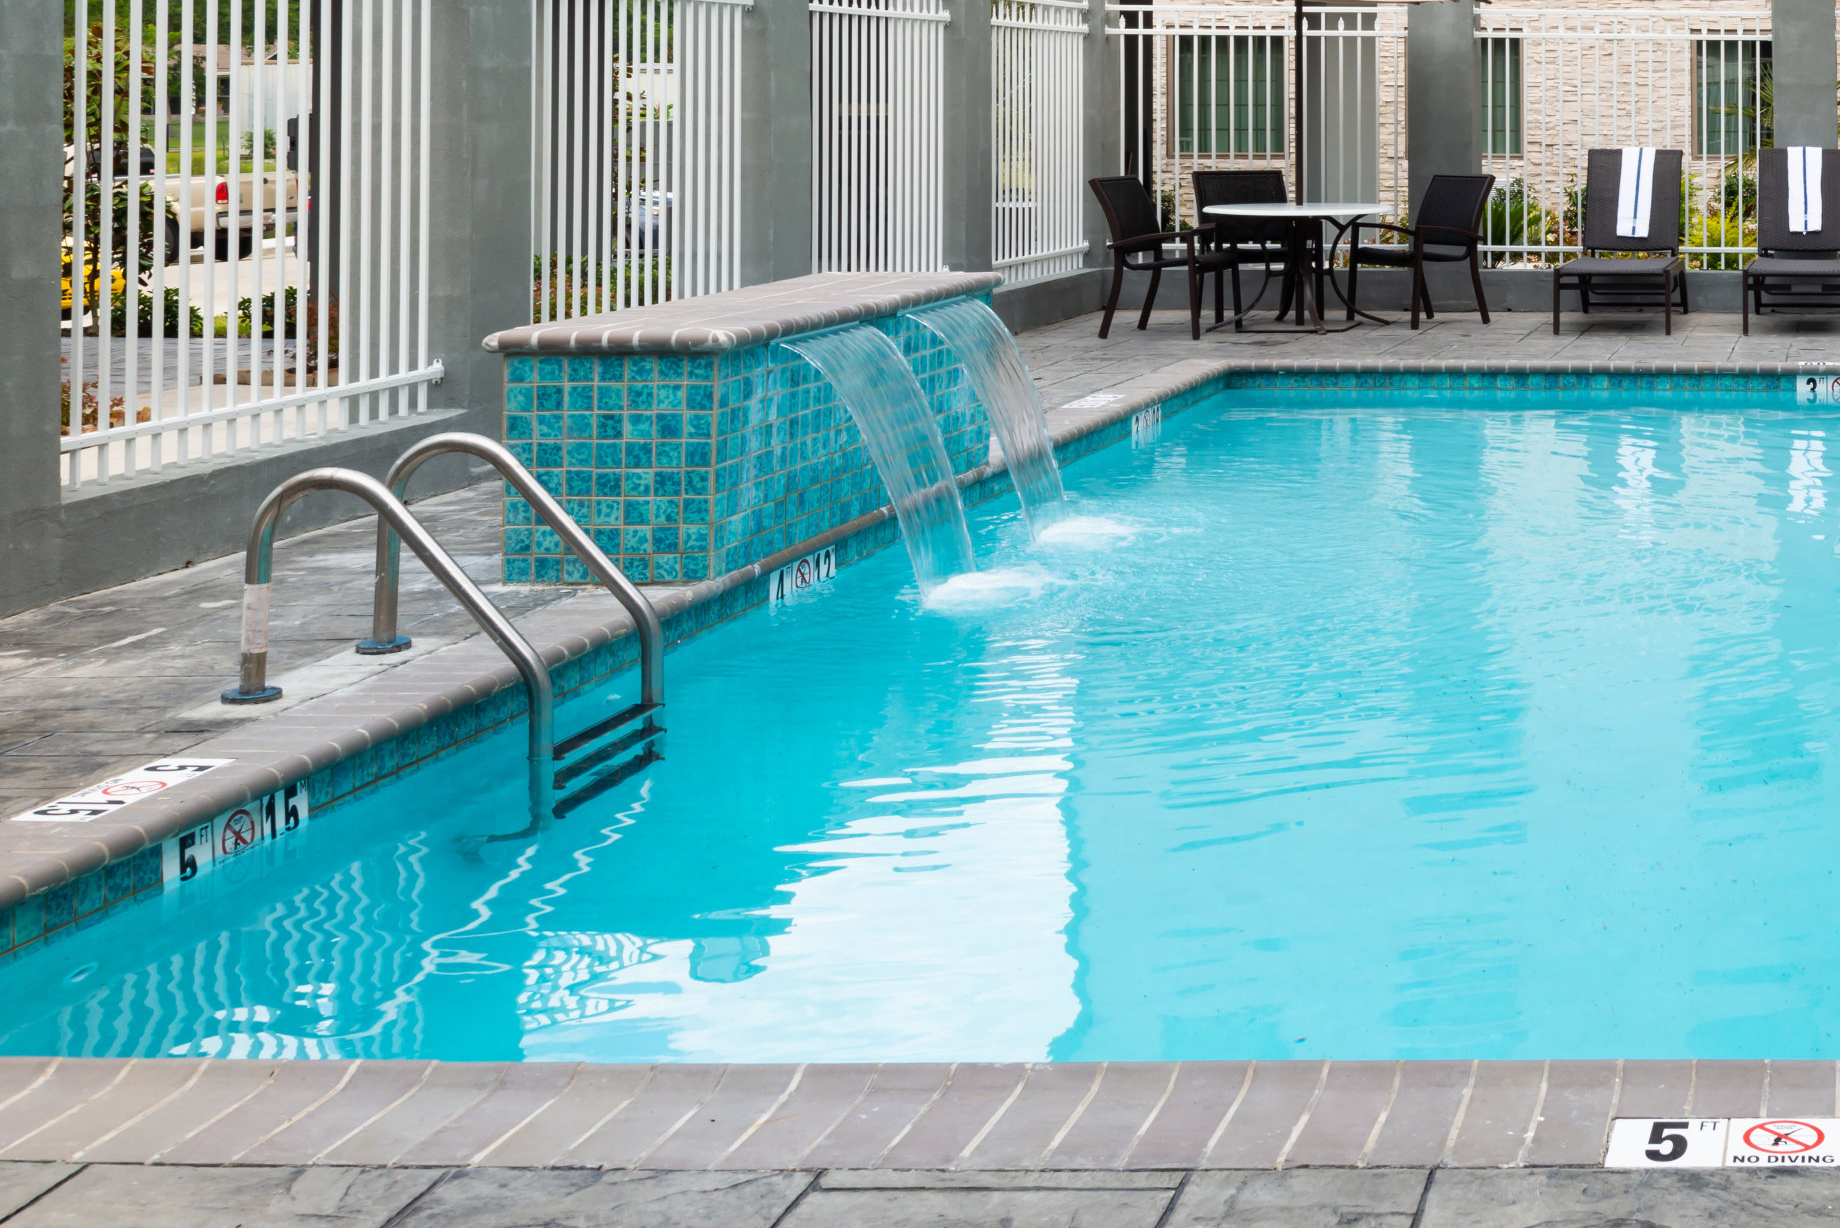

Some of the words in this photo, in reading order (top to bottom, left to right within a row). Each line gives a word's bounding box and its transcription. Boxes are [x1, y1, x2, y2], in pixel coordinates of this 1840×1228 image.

[179, 832, 198, 882] 5
[200, 825, 209, 845] FT
[1645, 1121, 1689, 1162] 5
[1700, 1121, 1720, 1131] FT
[1733, 1155, 1760, 1163] NO
[1767, 1155, 1835, 1163] DIVING
